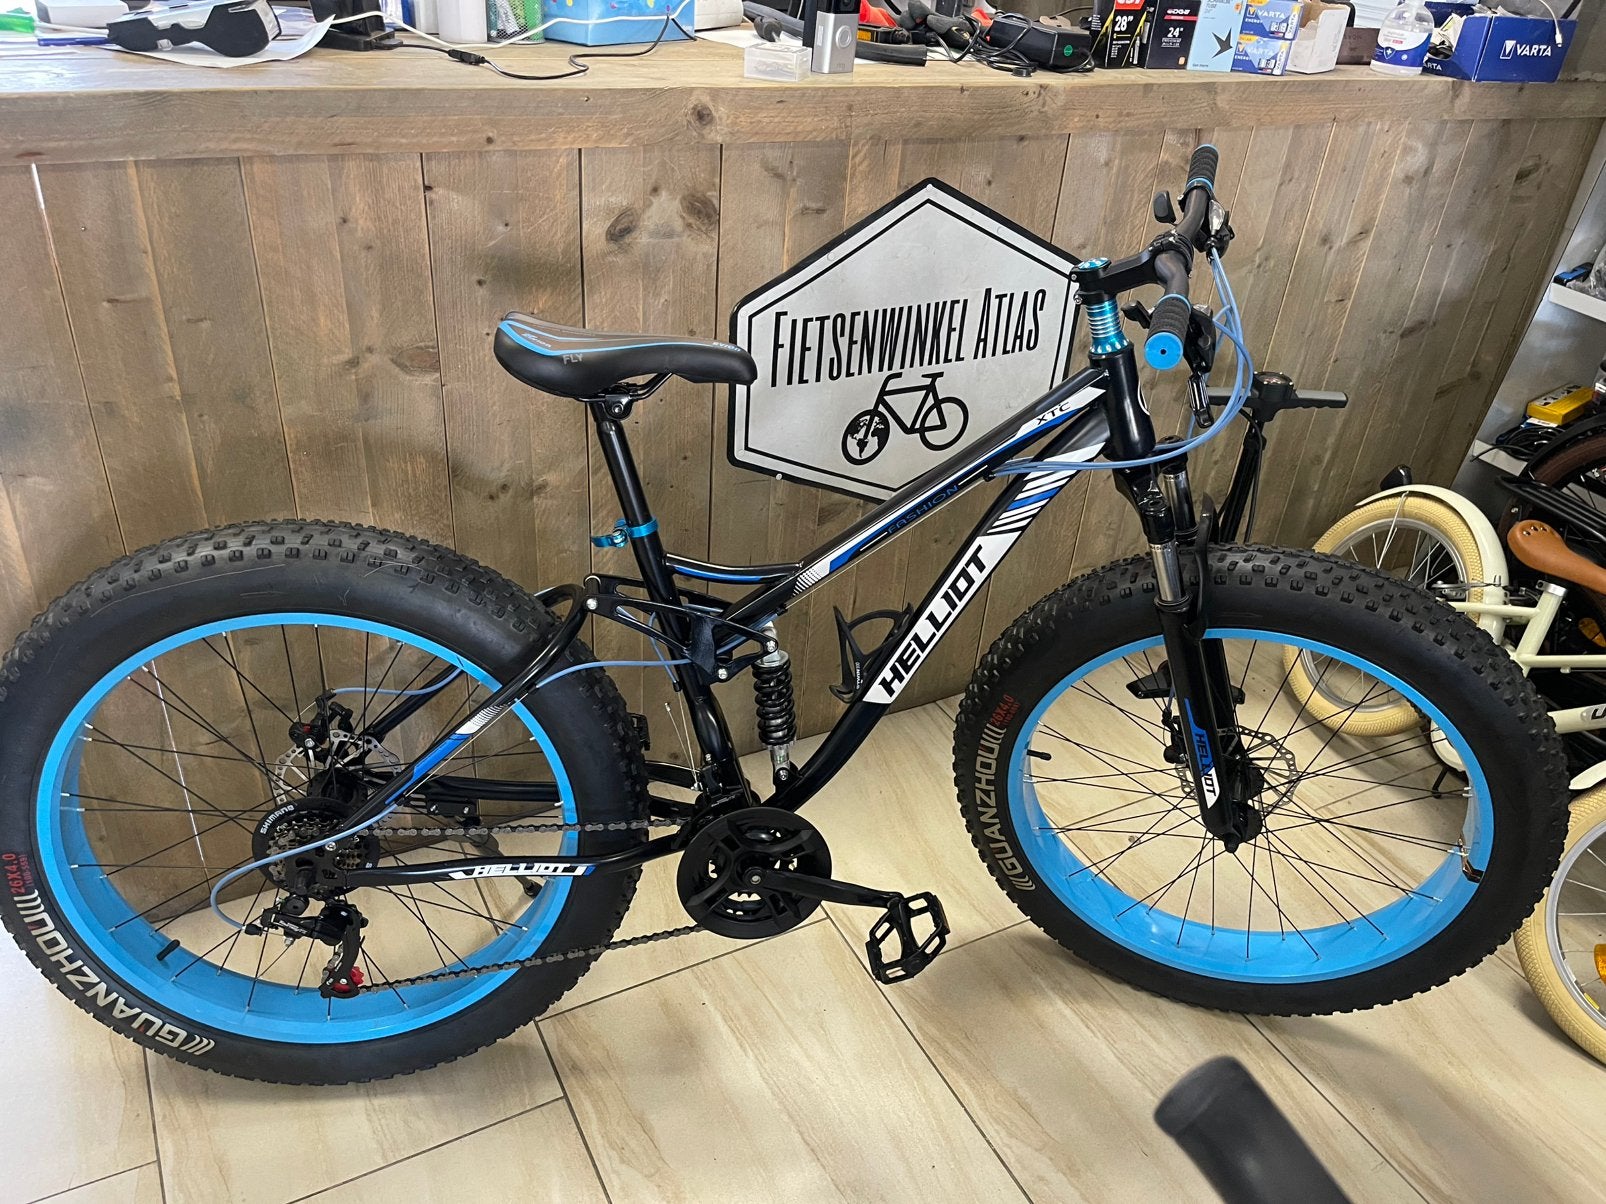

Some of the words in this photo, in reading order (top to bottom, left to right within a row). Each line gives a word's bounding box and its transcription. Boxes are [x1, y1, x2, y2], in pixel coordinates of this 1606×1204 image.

[1257, 10, 1286, 20] VARTA
[1422, 60, 1443, 72] ARTA
[1515, 43, 1552, 57] VARTA
[771, 299, 969, 388] FIETSENWINKEL
[973, 287, 1047, 360] ATLAS
[562, 353, 583, 365] FLY
[1036, 401, 1071, 426] XTC
[887, 484, 960, 534] FASHION
[878, 543, 987, 698] HELLIOT
[259, 804, 295, 835] SHIMANO
[974, 738, 1024, 876] GUANZHOU
[2, 853, 26, 894] 26X4.0
[23, 910, 188, 1049] GUANZHOU
